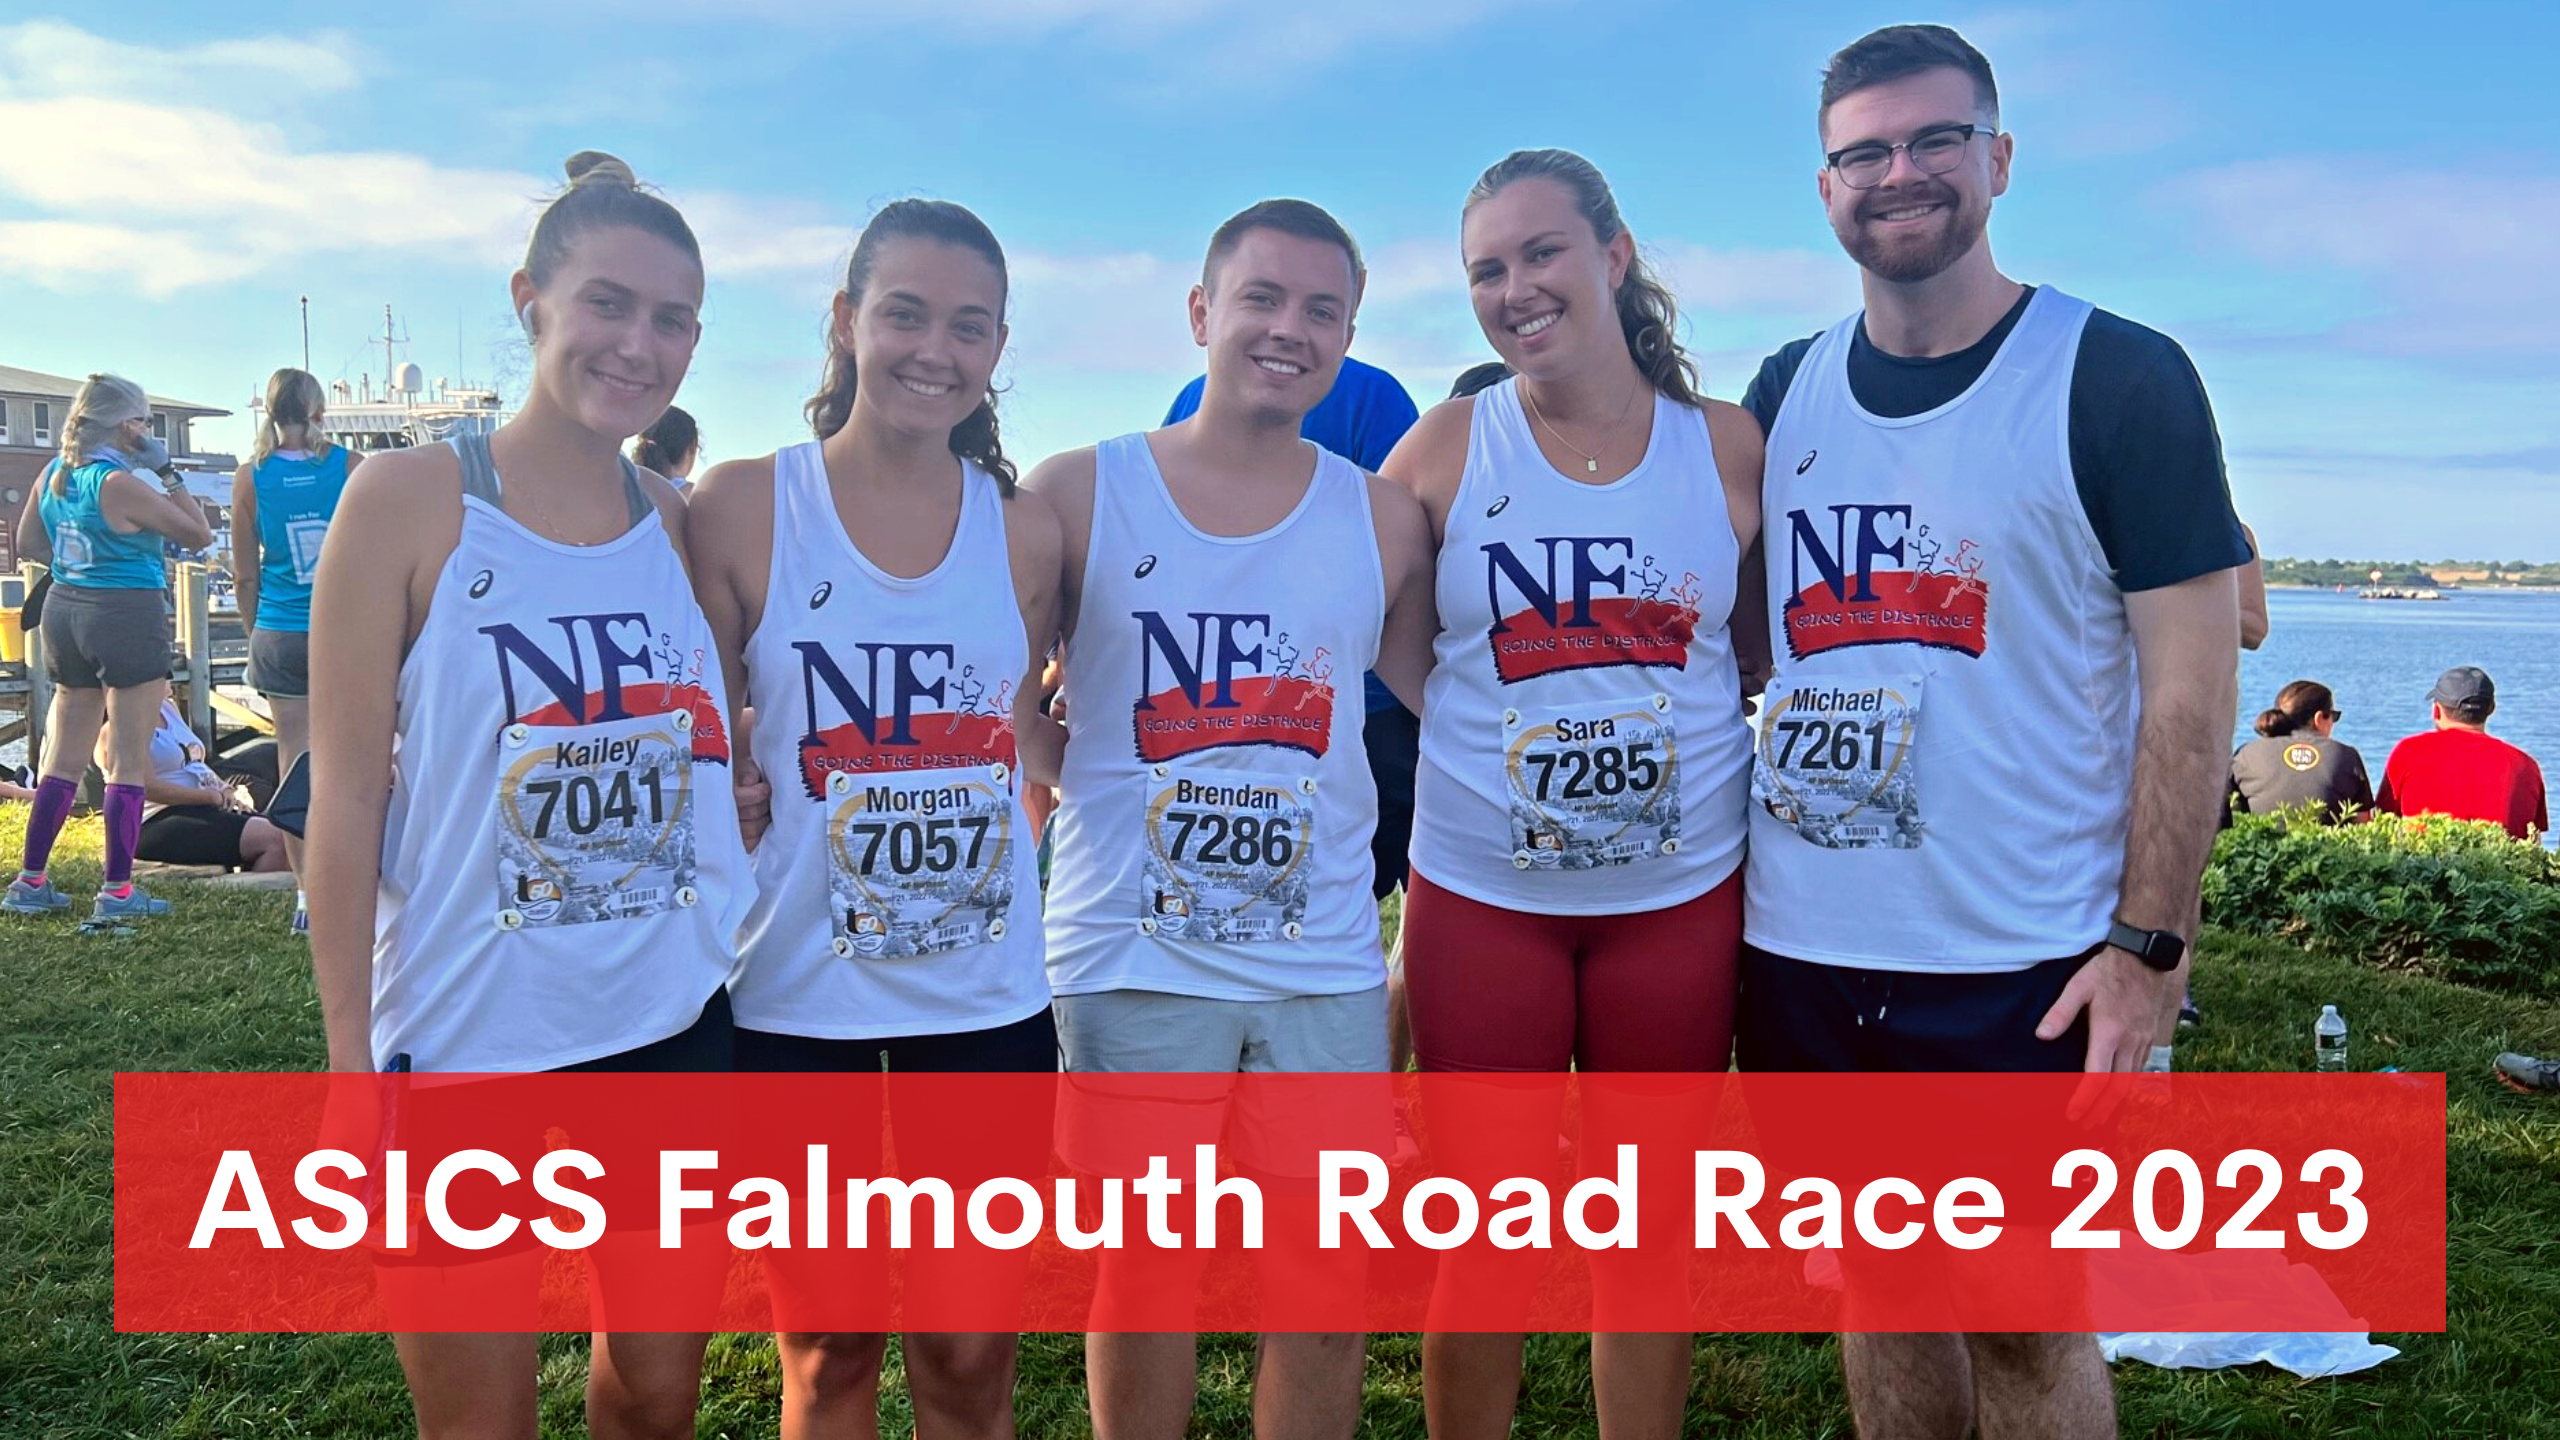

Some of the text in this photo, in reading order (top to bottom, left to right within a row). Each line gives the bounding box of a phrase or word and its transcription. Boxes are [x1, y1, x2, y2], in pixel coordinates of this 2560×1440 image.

[1787, 504, 1912, 606] NF
[1480, 537, 1633, 634] NF
[1502, 637, 1557, 654] GOING
[1562, 635, 1597, 649] THE
[1795, 611, 1843, 629] GOING
[1847, 610, 1876, 625] THE
[478, 612, 653, 725] NF
[1132, 611, 1270, 711] NF
[791, 641, 953, 749] NF
[1790, 687, 1884, 713] Michael
[1143, 717, 1198, 733] GOING
[1203, 714, 1237, 729] THE
[1556, 718, 1616, 743] Sara
[1776, 720, 1884, 771] 7261
[555, 736, 640, 771] Kailey
[813, 755, 874, 770] GOING
[879, 754, 916, 769] THE
[1526, 742, 1659, 801] 7285
[526, 767, 663, 840] 7041
[866, 786, 970, 817] Morgan
[1176, 779, 1279, 810] Brendan
[852, 816, 989, 876] 7057
[1167, 812, 1292, 867] 7286
